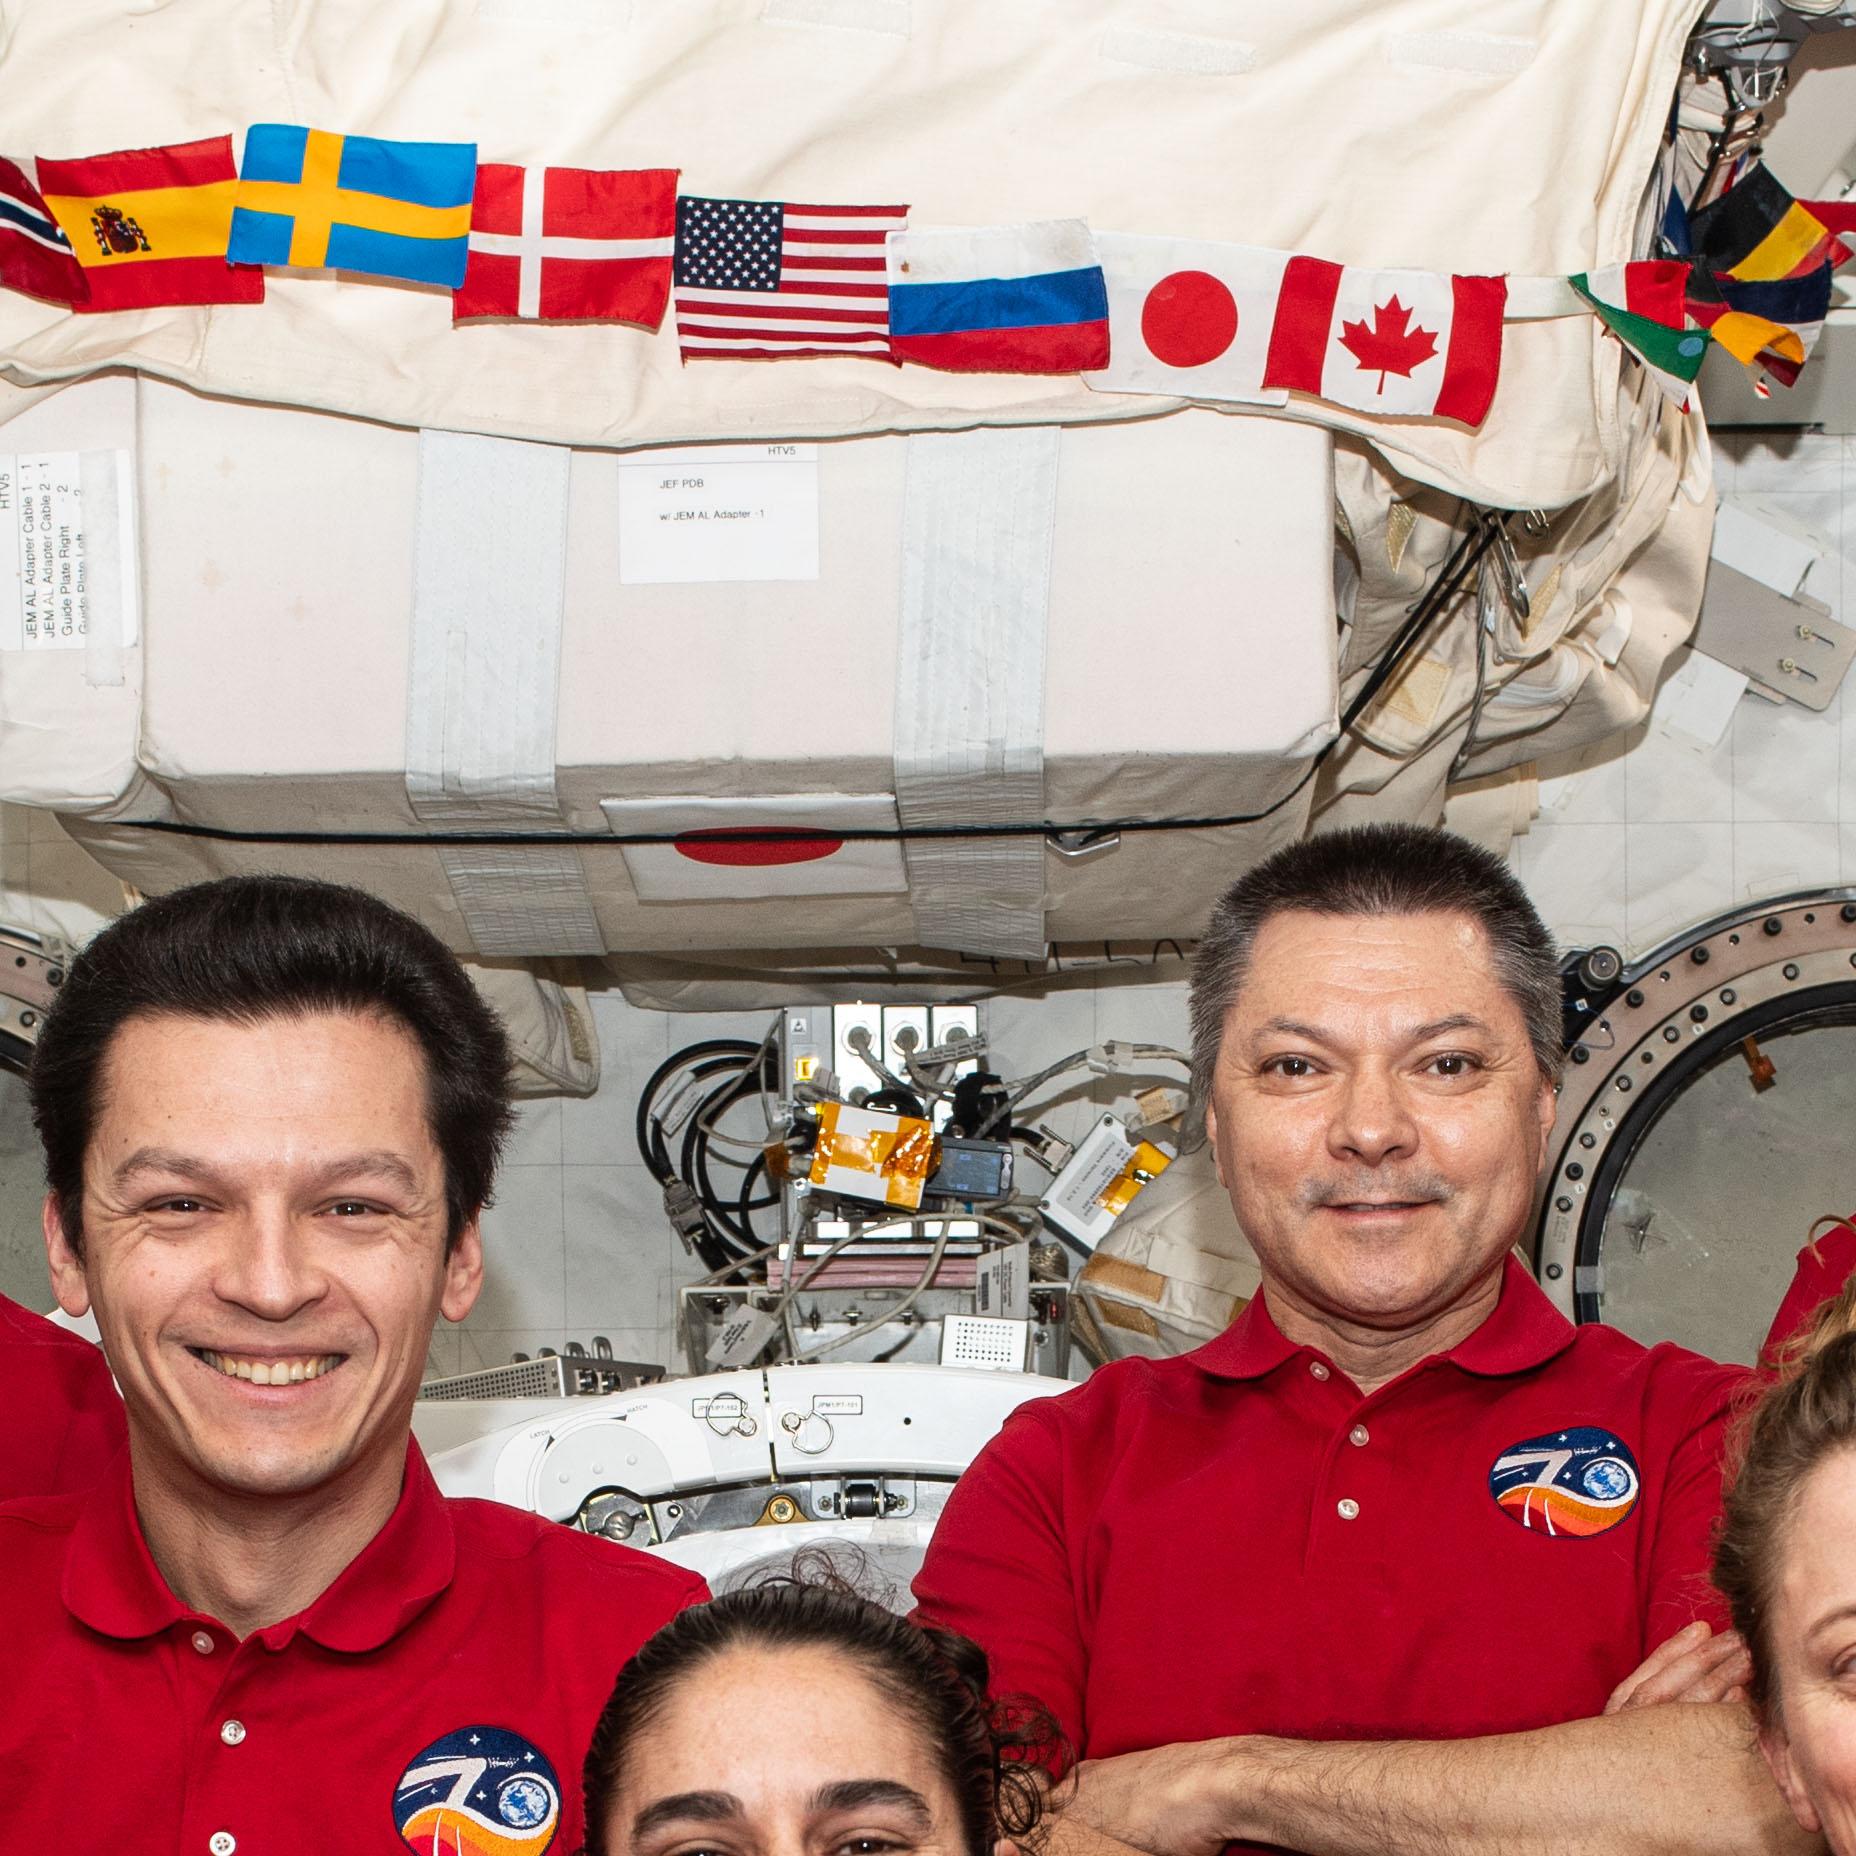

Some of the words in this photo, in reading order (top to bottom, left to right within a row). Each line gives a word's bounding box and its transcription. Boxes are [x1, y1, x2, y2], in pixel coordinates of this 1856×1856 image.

[768, 446, 796, 455] HTV5
[40, 482, 50, 490] 2
[660, 480, 678, 488] JEF
[682, 478, 703, 488] PDB
[22, 496, 33, 532] Cable
[40, 494, 51, 531] Cable
[673, 511, 694, 520] JEM
[697, 511, 710, 520] AL
[714, 510, 750, 520] Adapter
[59, 525, 72, 557] Right
[24, 537, 37, 584] Adapter
[41, 536, 55, 583] Adapter
[60, 562, 71, 594] Plate
[25, 590, 36, 606] AL
[43, 588, 53, 605] AL
[25, 611, 36, 638] JEM
[43, 609, 54, 637] JEM
[61, 598, 72, 635] Guide
